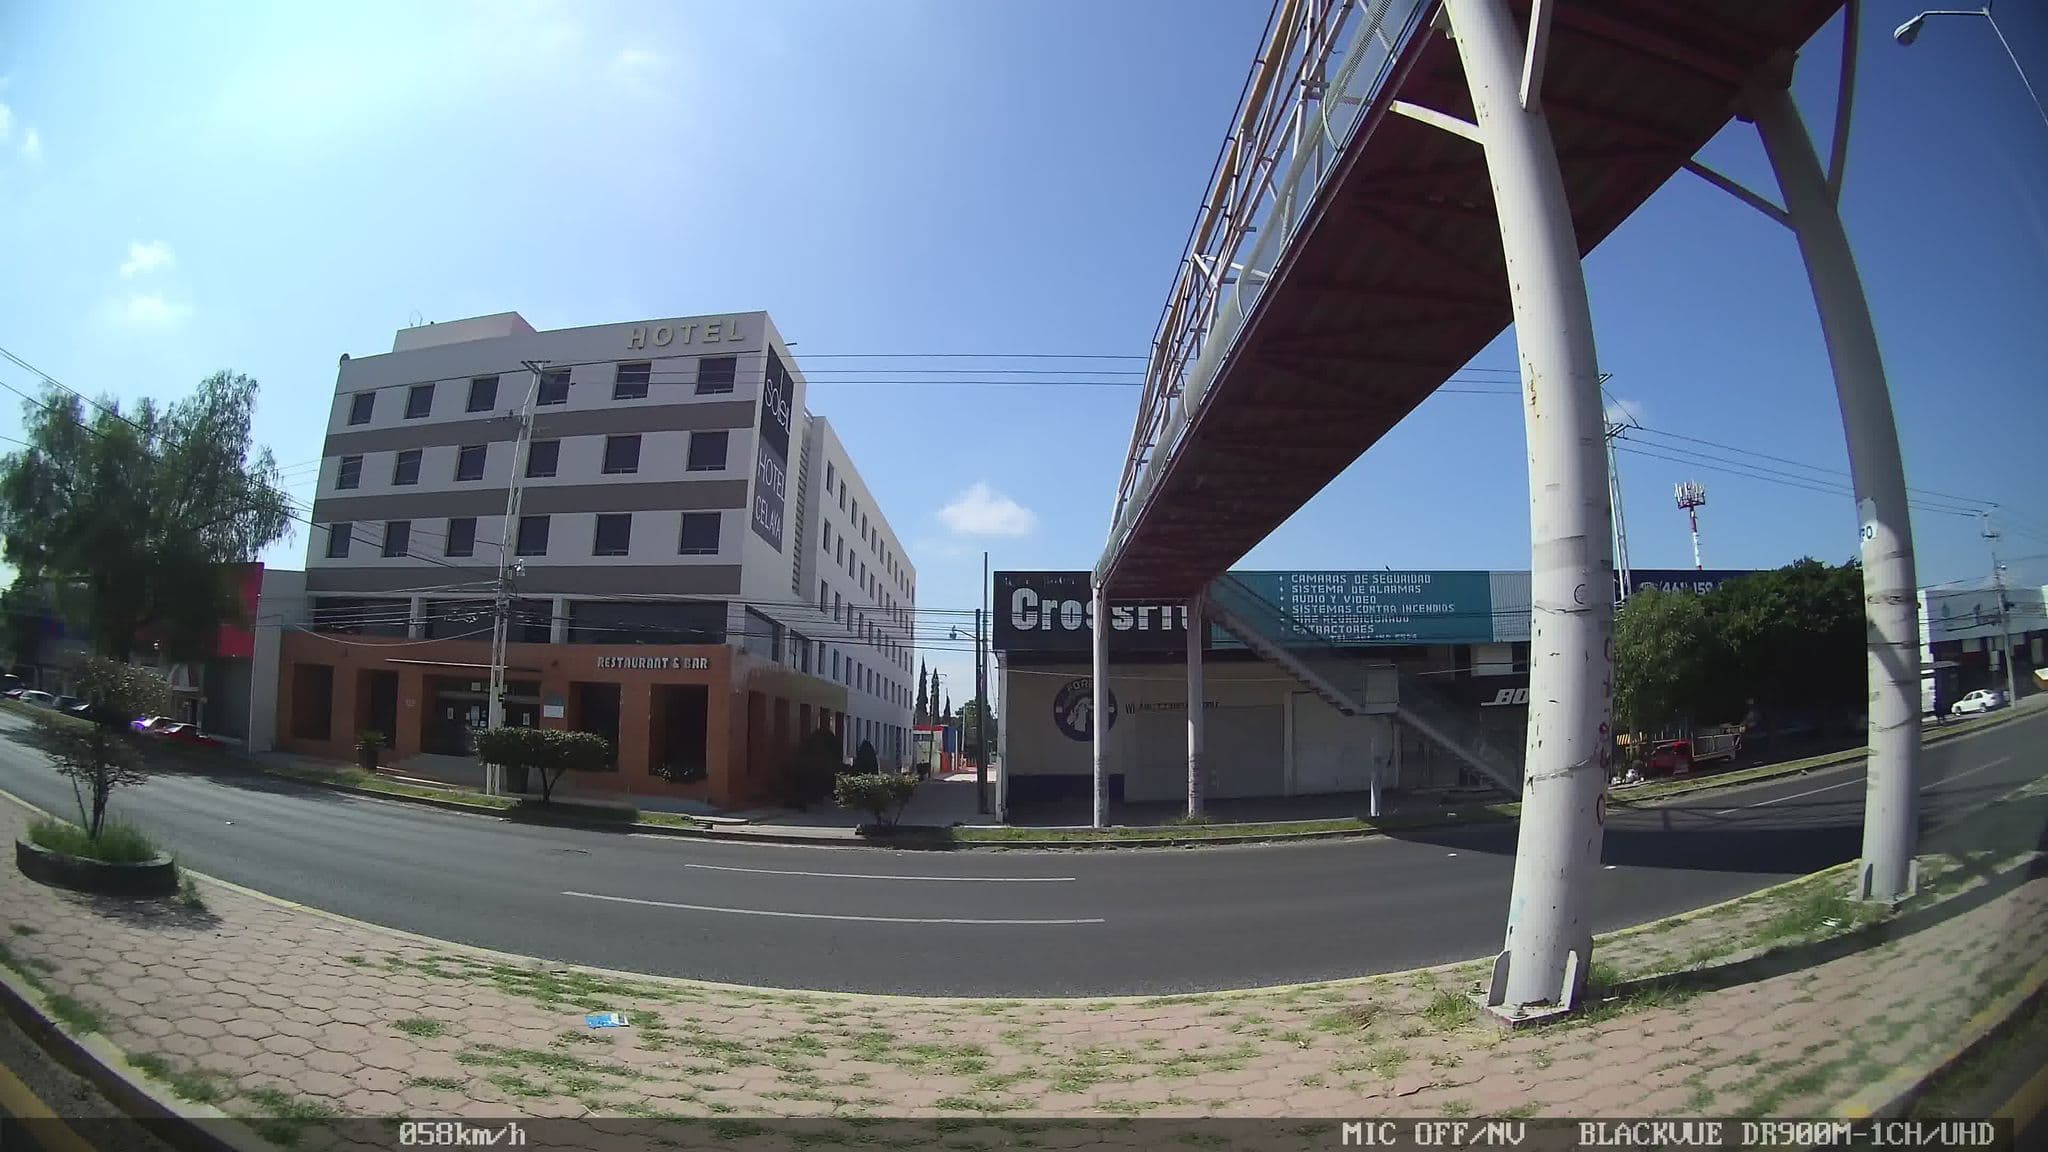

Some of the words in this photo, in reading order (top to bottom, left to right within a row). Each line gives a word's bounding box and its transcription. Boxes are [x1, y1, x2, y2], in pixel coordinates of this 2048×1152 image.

[627, 319, 744, 350] HOTEL
[758, 448, 784, 502] HOTEL
[755, 495, 781, 543] CELAYA
[1291, 574, 1347, 584] CAMARAS
[1354, 575, 1368, 584] DE
[1372, 574, 1431, 584] SEGURIDAD
[1291, 585, 1344, 594] SISTEMA
[1352, 585, 1365, 594] DE
[1292, 595, 1325, 604] AUDIO
[1330, 595, 1336, 603] Y
[1343, 595, 1376, 604] VIDEO
[1292, 604, 1352, 614] SISTEMAS
[1356, 605, 1397, 614] CONTRA
[1402, 603, 1455, 613] INCENDIOS
[597, 657, 669, 669] RESTAURANT
[684, 657, 708, 669] BAR
